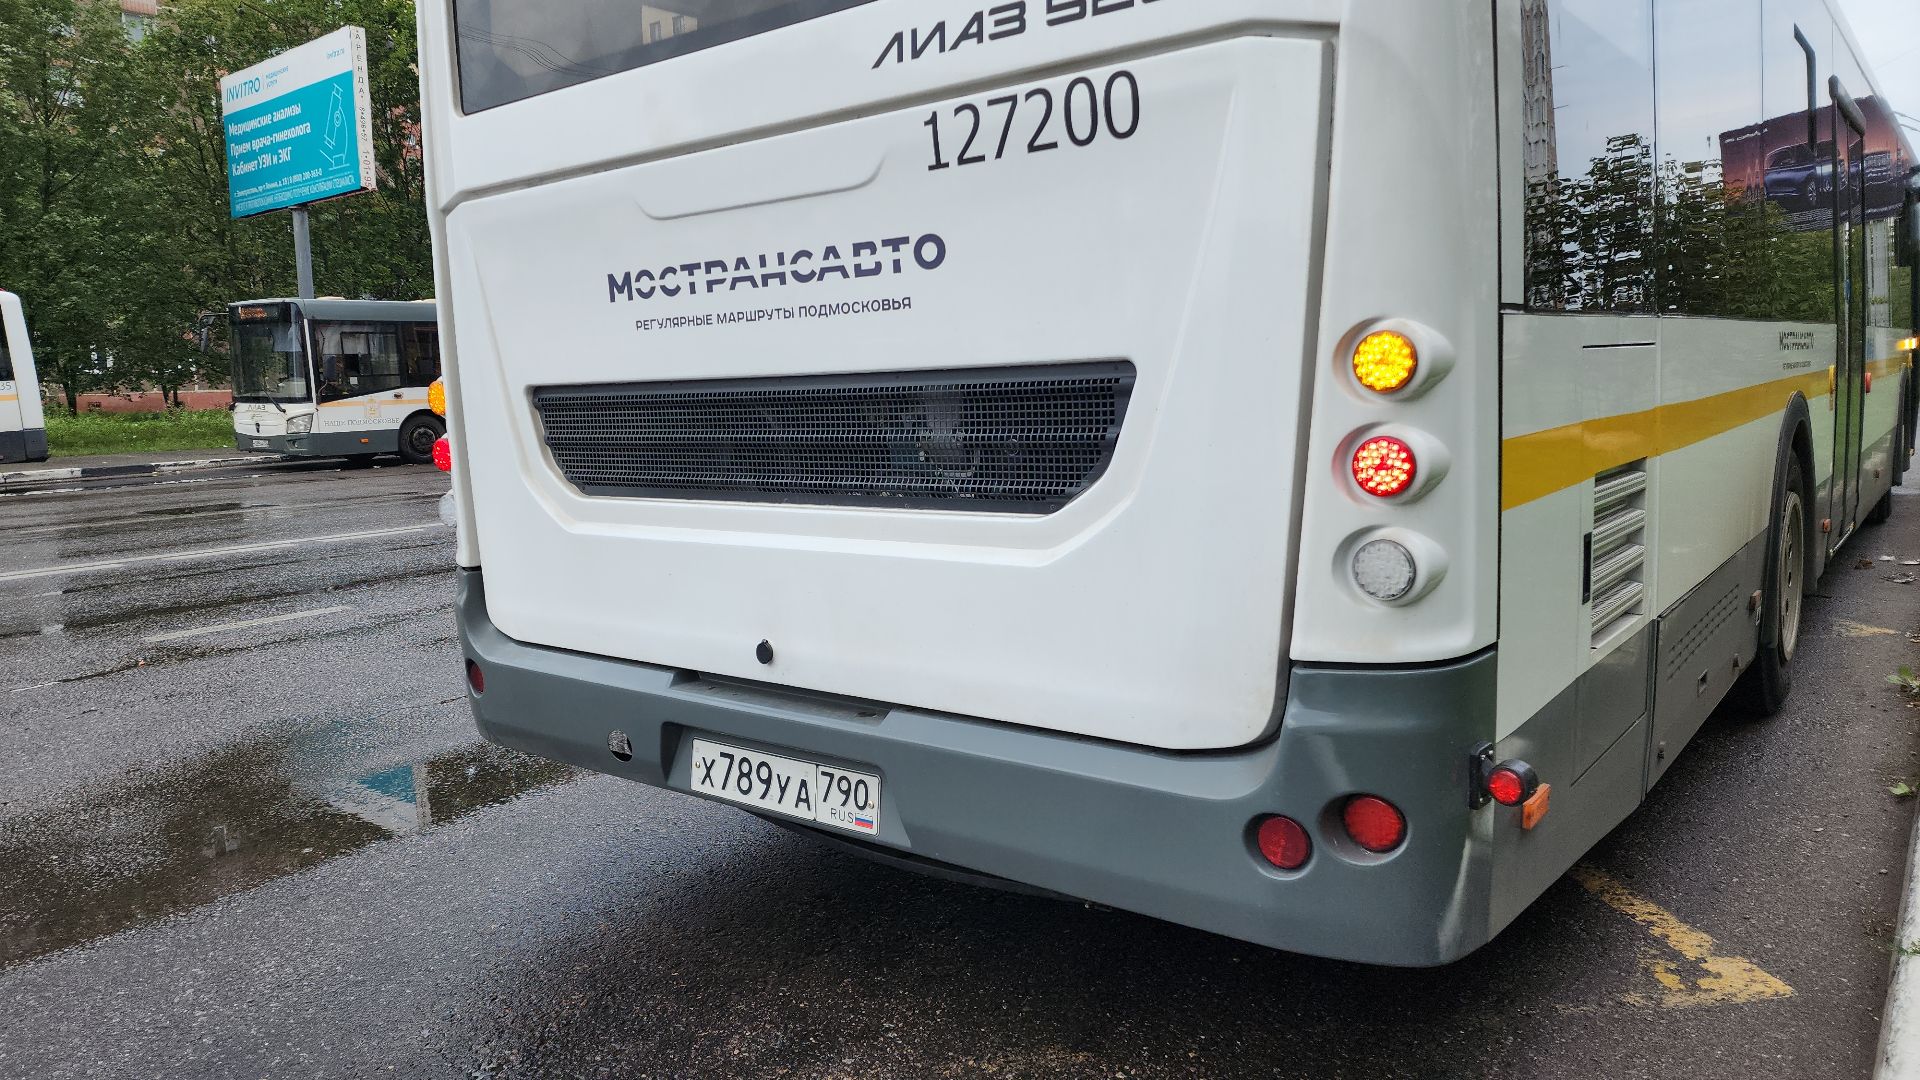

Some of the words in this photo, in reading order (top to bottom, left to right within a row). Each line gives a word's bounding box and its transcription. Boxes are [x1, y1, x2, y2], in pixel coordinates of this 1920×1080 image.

[871, 1, 1026, 69] ЛИАЗ
[226, 76, 261, 103] INVITRO
[228, 113, 272, 136] Медицинские
[273, 103, 301, 122] анализы
[924, 70, 1139, 171] 127200
[230, 141, 251, 159] Прием
[252, 122, 311, 152] врача-гинеколога
[232, 159, 258, 177] Кабинет
[258, 153, 272, 169] УЗИ
[272, 154, 278, 165] и
[278, 146, 292, 163] ЭКГ
[607, 233, 946, 303] МОСТРАНСАВТО
[635, 314, 713, 331] РЕГУЛЯРНЫЕ
[717, 306, 795, 326] МАРШРУТЫ
[798, 296, 912, 319] ПОДМОСКОВЬЯ
[820, 771, 869, 811] 790
[830, 807, 854, 824] RUS
